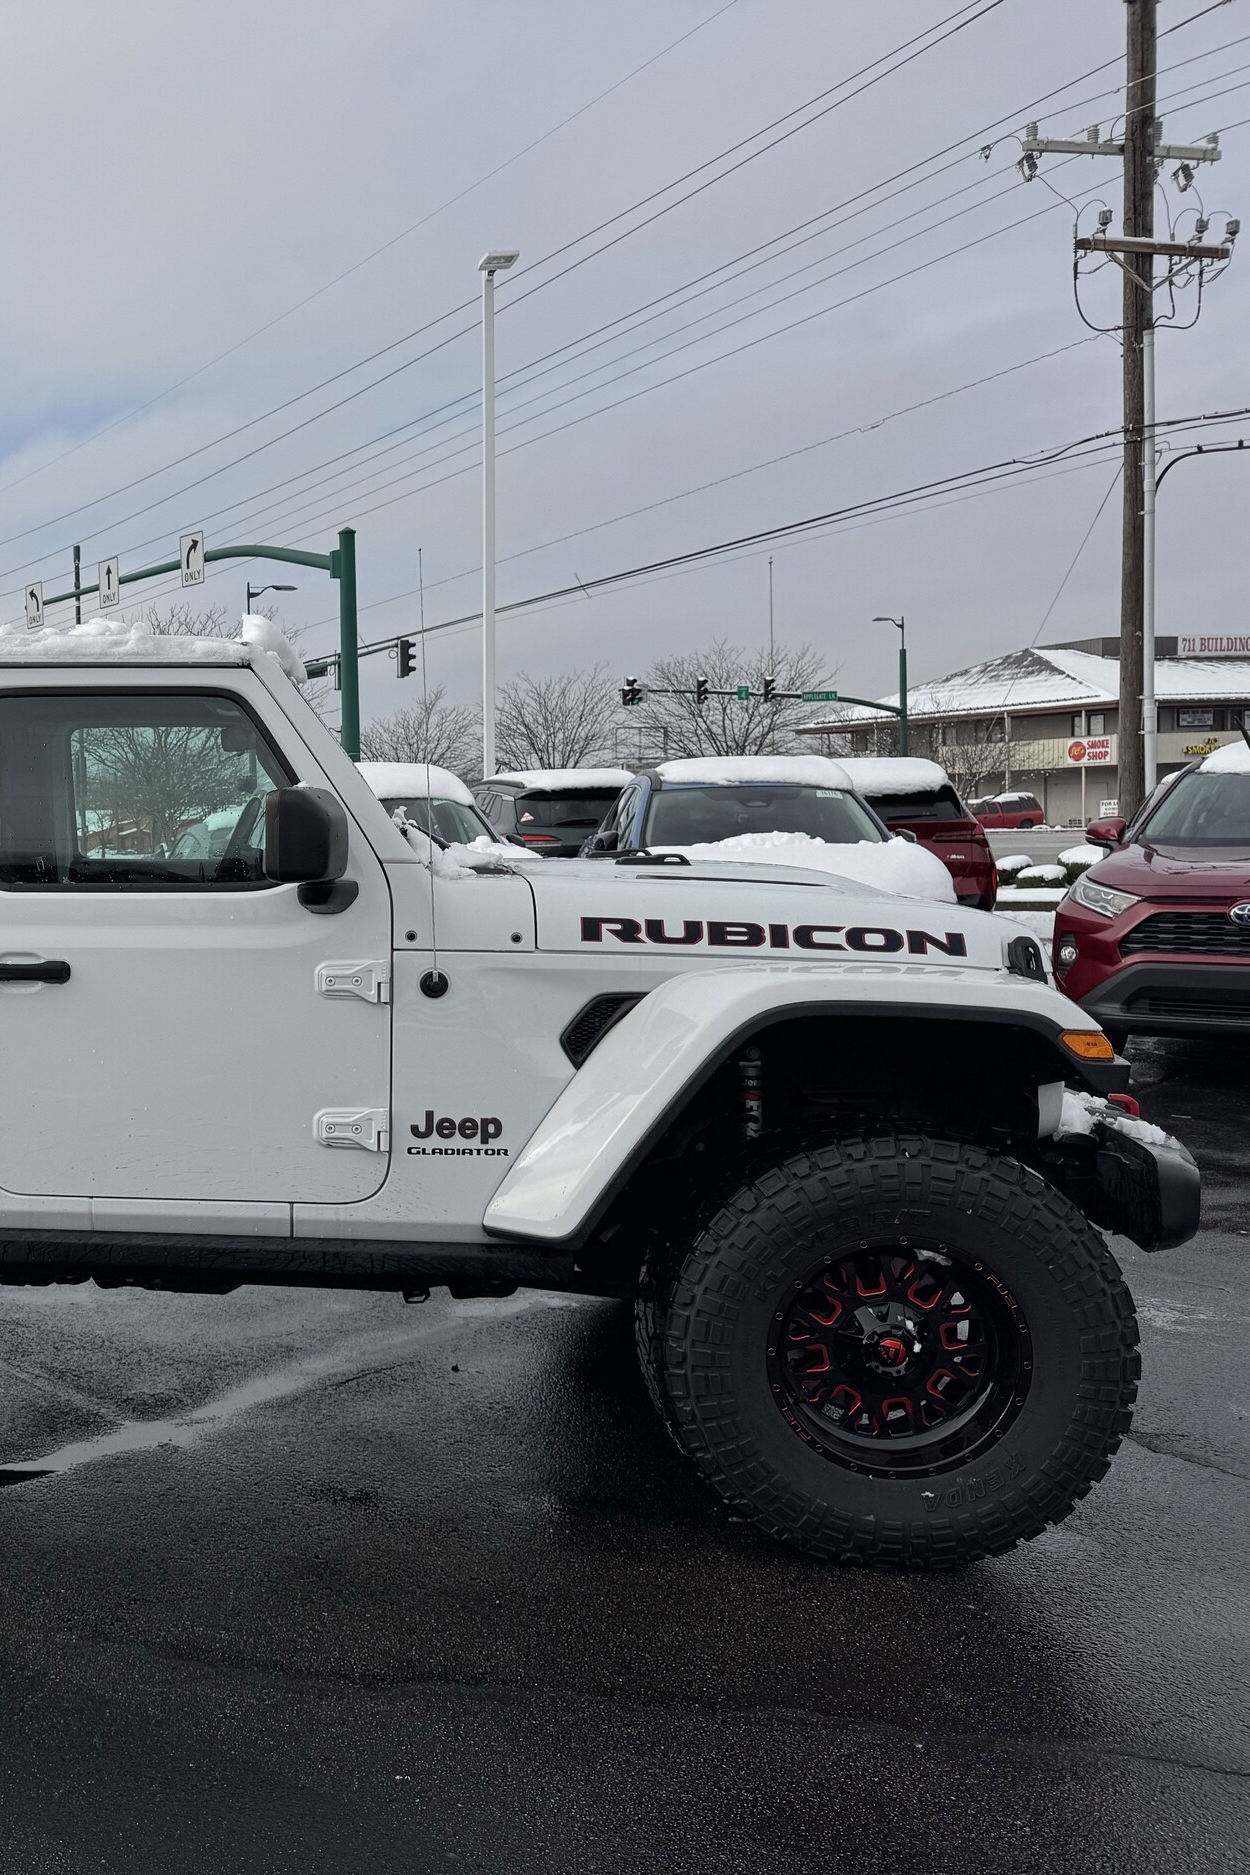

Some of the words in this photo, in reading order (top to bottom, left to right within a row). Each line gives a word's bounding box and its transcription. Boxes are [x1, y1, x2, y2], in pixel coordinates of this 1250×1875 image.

[184, 569, 201, 582] ONLY
[102, 592, 116, 604] ONLY
[29, 614, 42, 625] ONLY
[1181, 637, 1196, 652] 711
[1086, 739, 1110, 750] SMOKE
[1087, 751, 1109, 761] SHOP
[579, 915, 969, 958] RUBICON
[410, 1110, 503, 1145] Jeep
[406, 1147, 510, 1156] GLADIATOR
[986, 1275, 1019, 1318] FUEL
[922, 1452, 1027, 1512] KENDA
